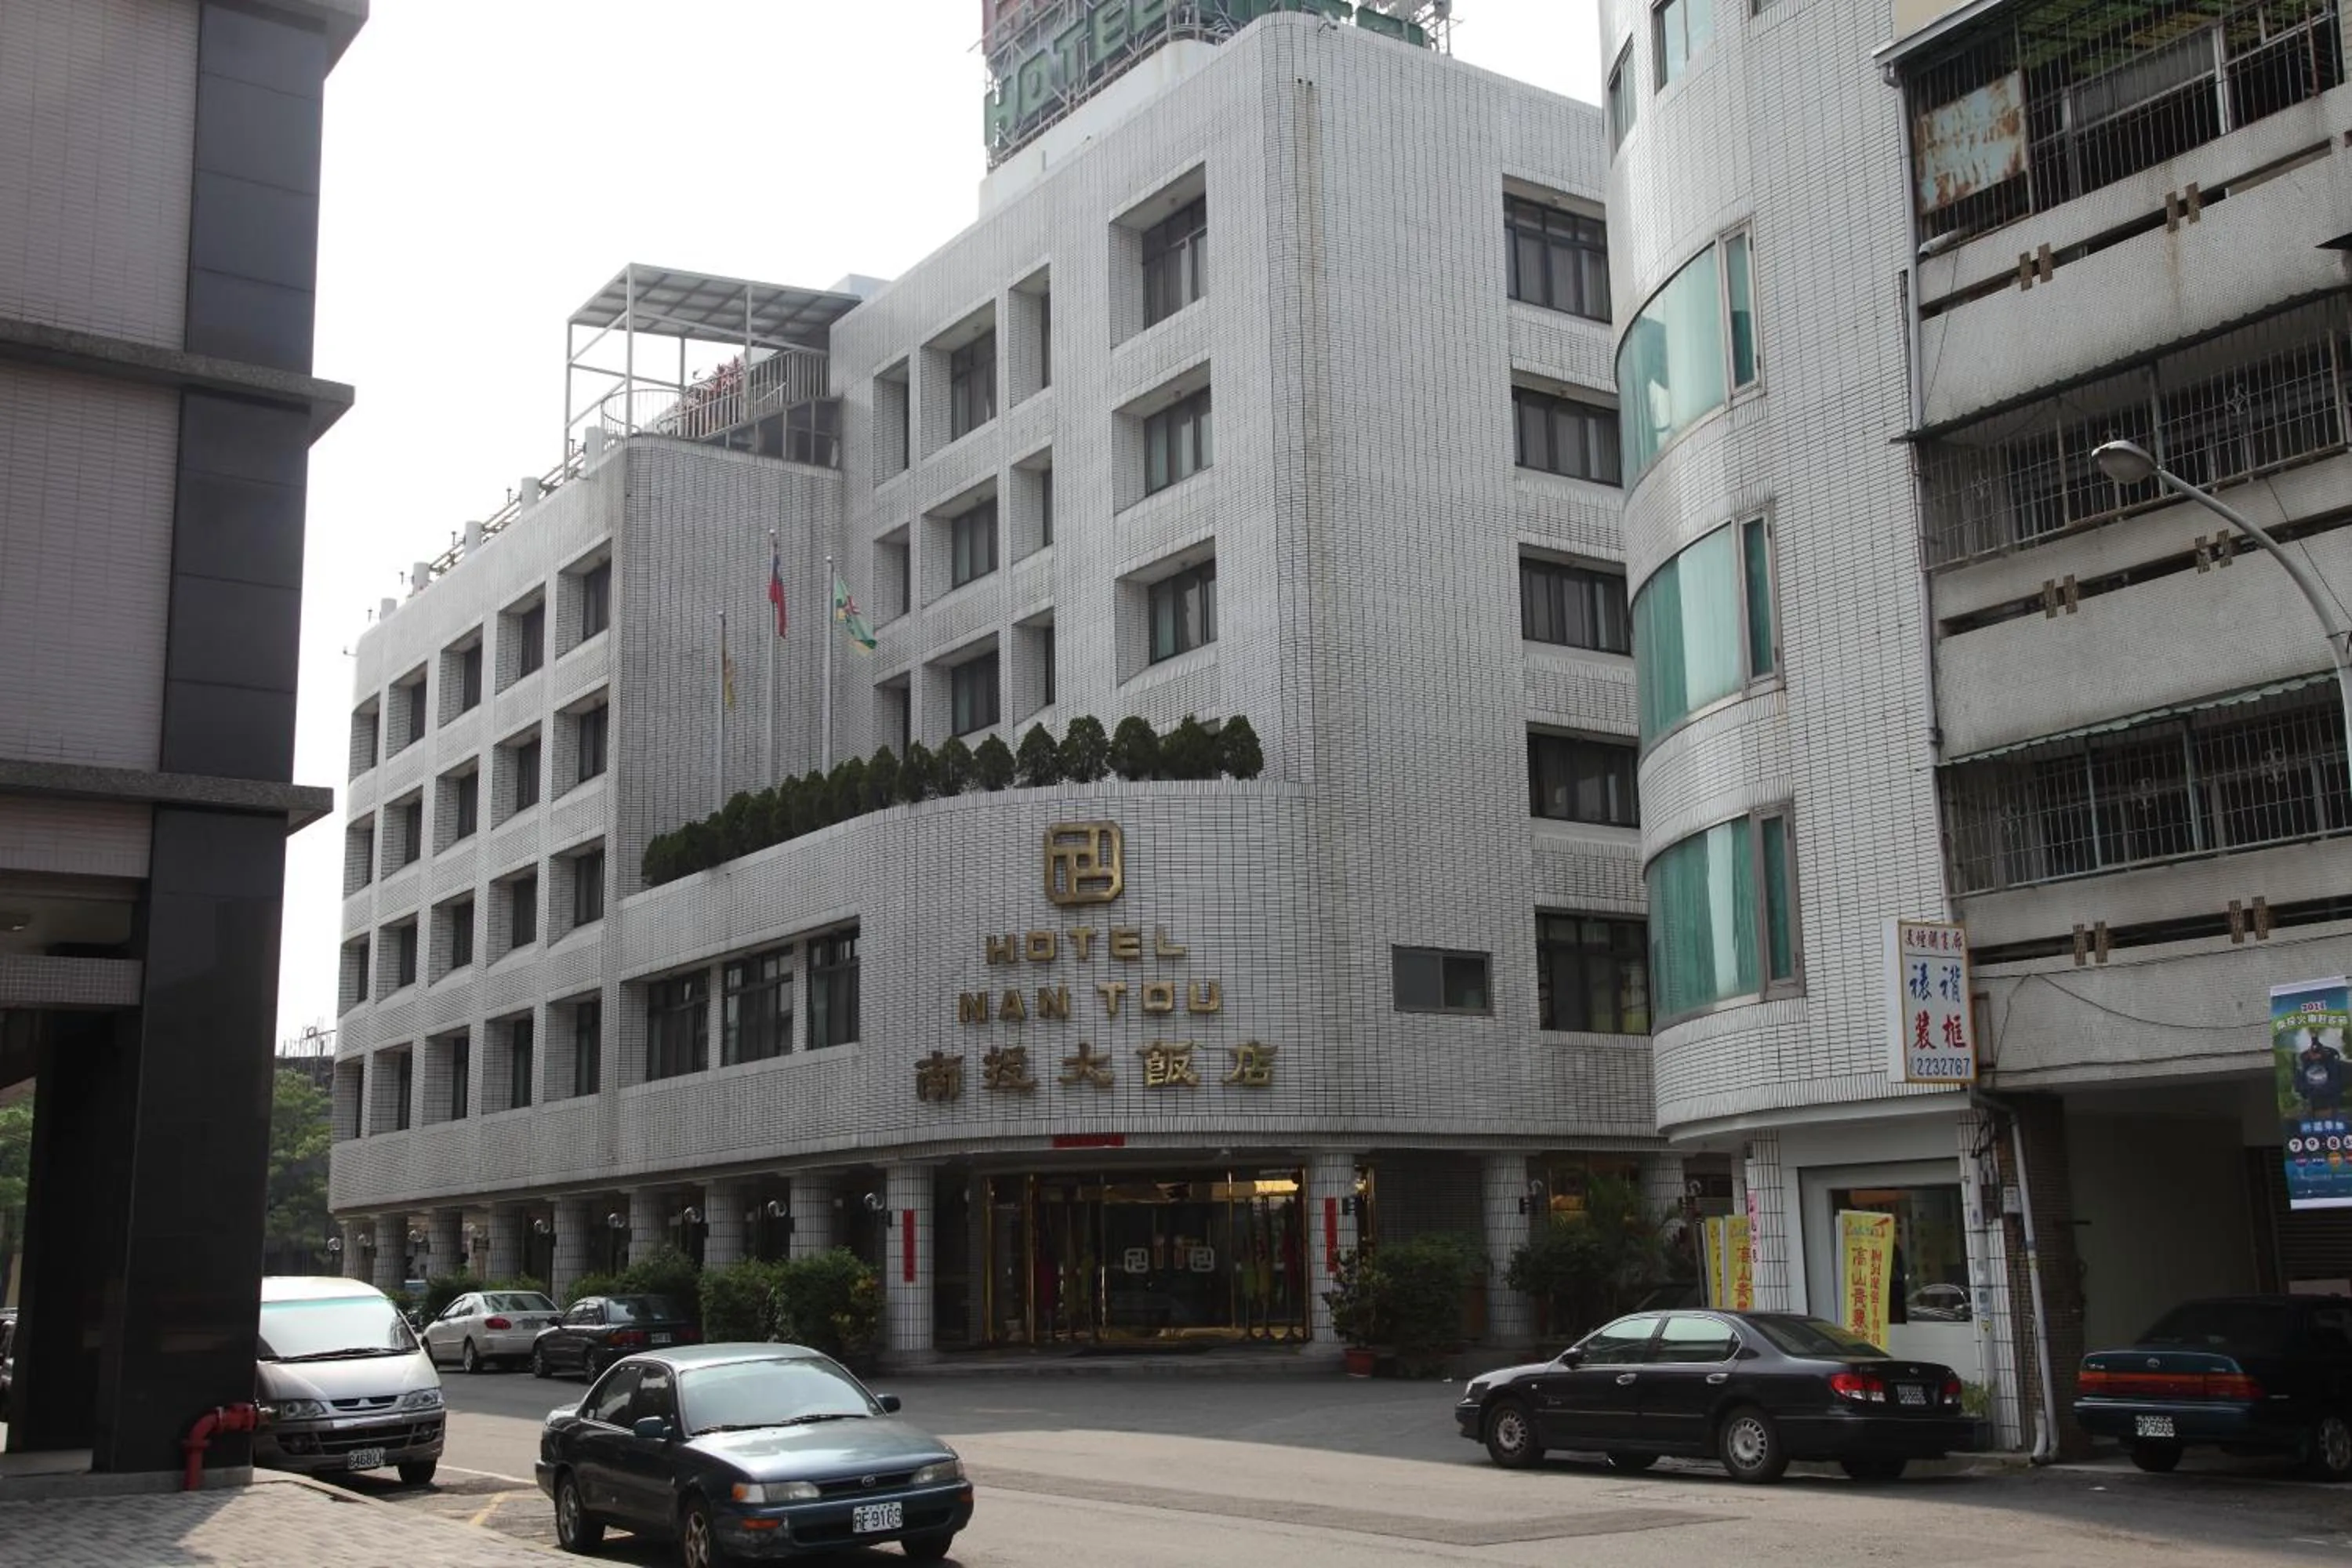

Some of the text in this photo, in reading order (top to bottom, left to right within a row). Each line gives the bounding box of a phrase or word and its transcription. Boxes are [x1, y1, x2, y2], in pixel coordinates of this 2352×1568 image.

[985, 924, 1186, 964] HOTEL
[959, 980, 1221, 1024] NAN TOU
[1909, 963, 1962, 1002] 裱褙
[1913, 1010, 1966, 1049] 裝框
[916, 1040, 1279, 1101] 南投大飯店
